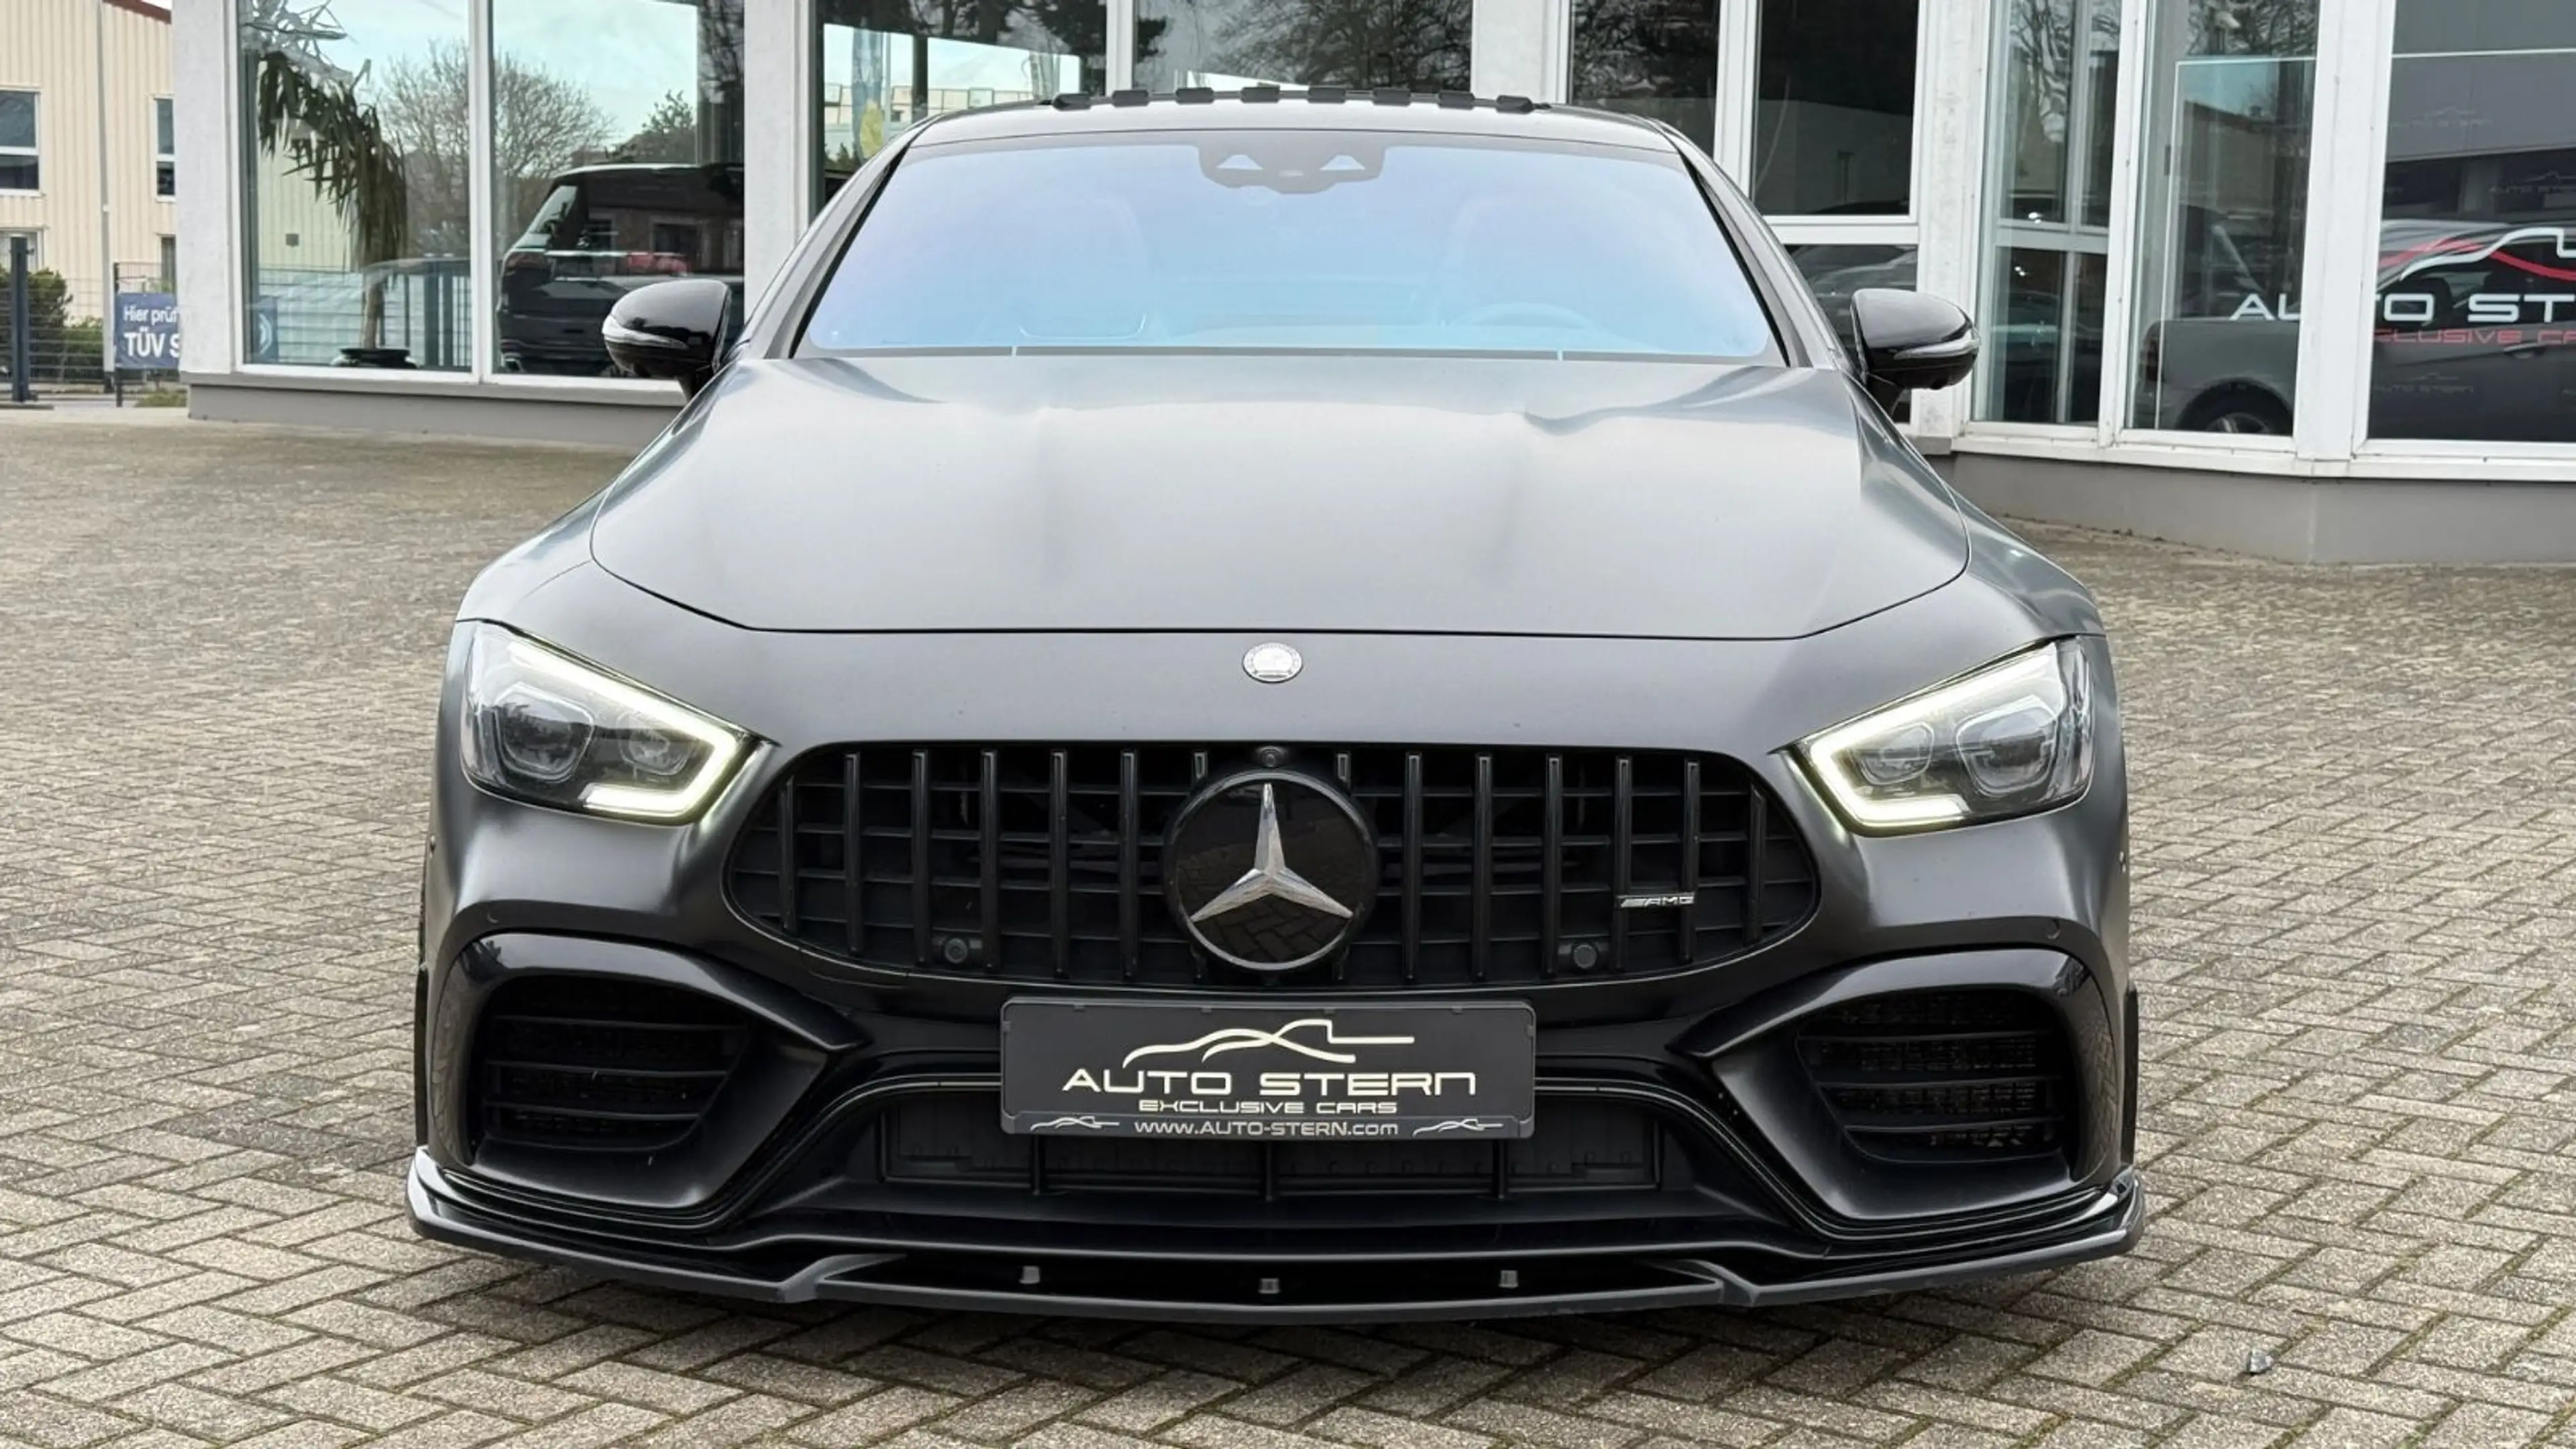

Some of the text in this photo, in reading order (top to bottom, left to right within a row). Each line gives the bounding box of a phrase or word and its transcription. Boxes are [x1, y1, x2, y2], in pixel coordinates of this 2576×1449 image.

[123, 305, 148, 321] Hier
[124, 327, 166, 358] TÜV
[1062, 1068, 1476, 1096] AUTO STERN
[1138, 1099, 1397, 1114] EXCLUSIVE CARS
[1134, 1121, 1398, 1136] www.AUTO-STERN.com
